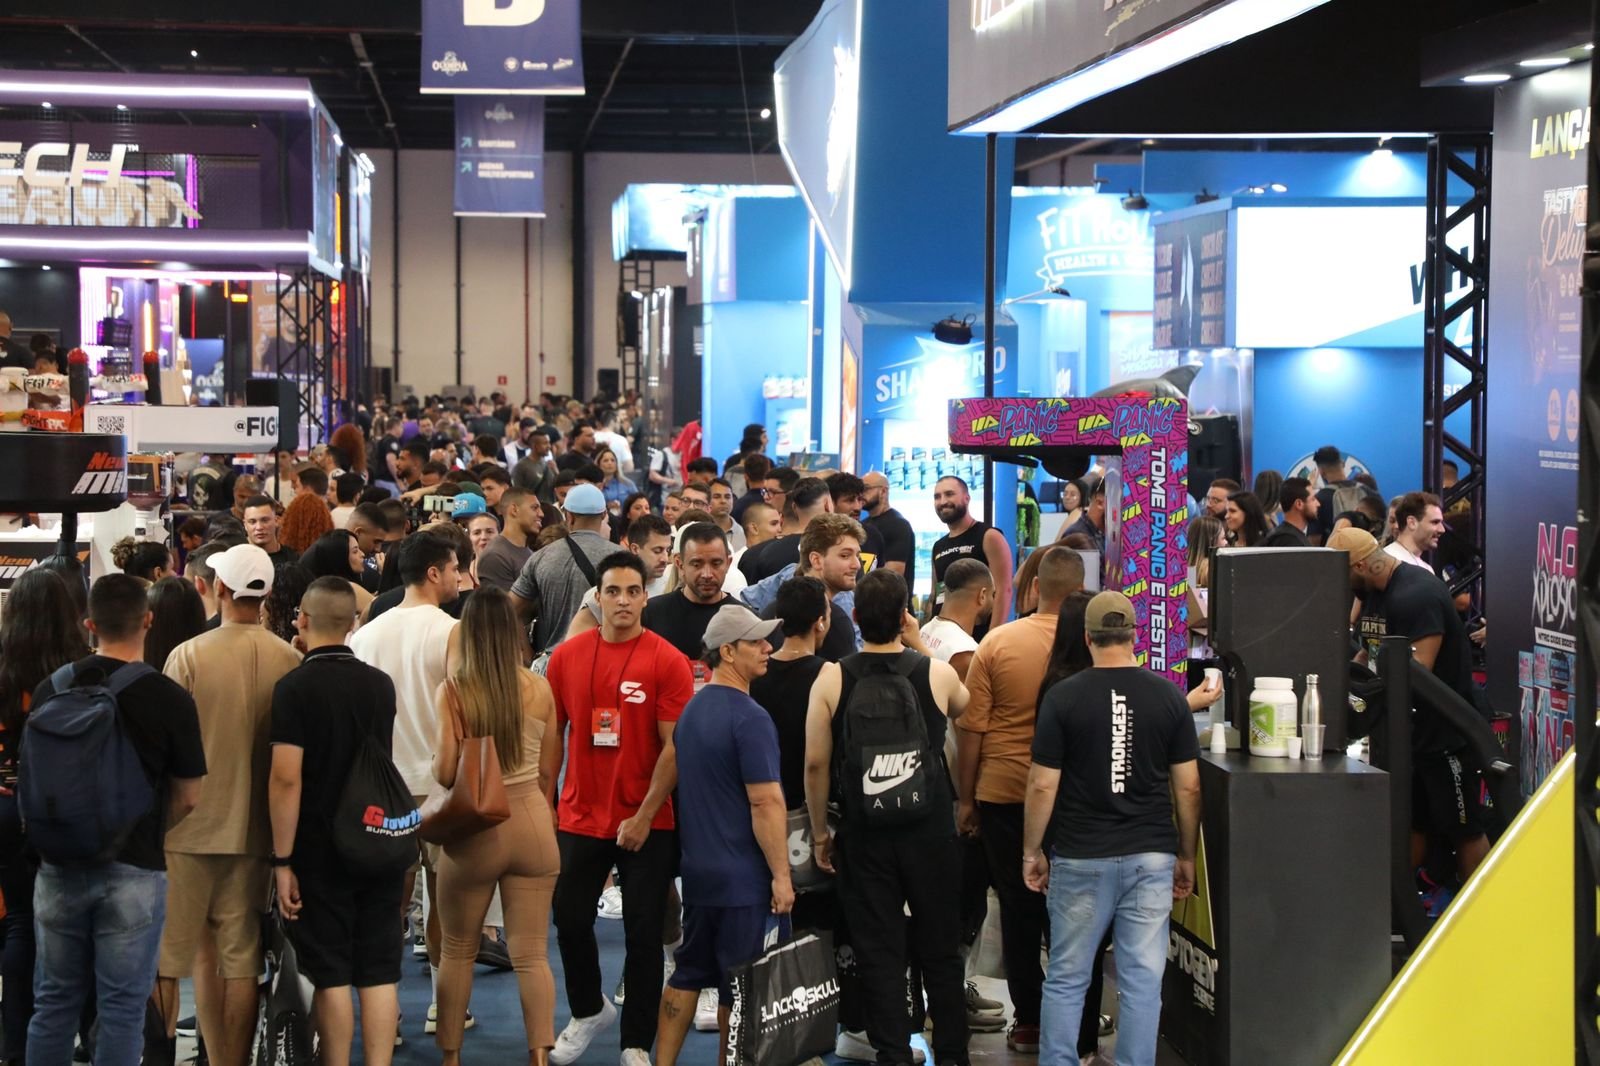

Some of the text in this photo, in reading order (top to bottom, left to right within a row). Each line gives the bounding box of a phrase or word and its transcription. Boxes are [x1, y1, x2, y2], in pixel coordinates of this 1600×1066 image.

[235, 416, 278, 437] @FIG
[1000, 403, 1058, 437] PANIC
[1113, 402, 1173, 437] PANIC
[1151, 447, 1166, 671] TOME PANIC E TESTE
[1111, 689, 1127, 793] STRONGEST
[1126, 709, 1134, 777] SUPPLEMENTS
[869, 750, 917, 778] NIKE
[873, 791, 920, 809] AIR
[806, 977, 840, 1005] SKULL
